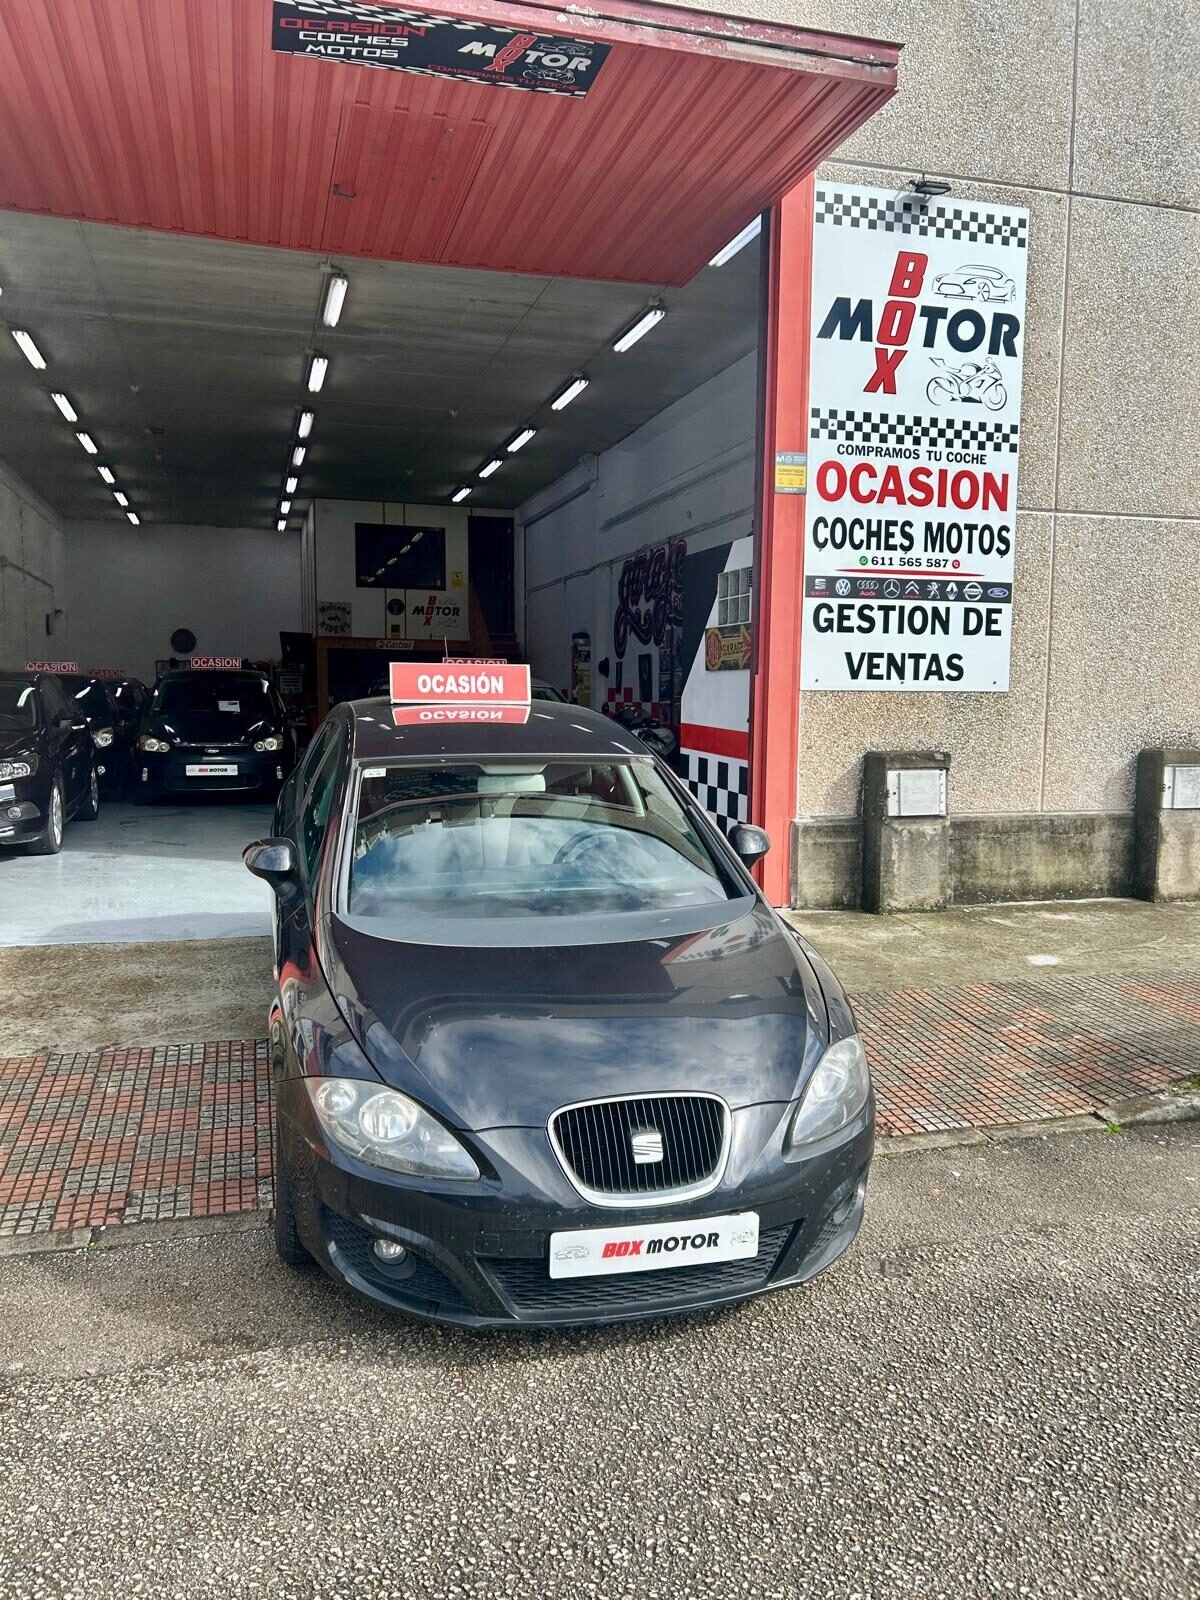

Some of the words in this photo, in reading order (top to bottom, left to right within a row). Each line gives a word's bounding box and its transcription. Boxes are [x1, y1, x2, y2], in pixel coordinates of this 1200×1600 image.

[279, 17, 427, 37] OCASION
[298, 32, 409, 47] COCHES
[305, 44, 399, 58] MOTOS
[458, 41, 593, 71] MOTOR
[484, 33, 538, 73] BOX
[427, 63, 515, 82] COMPRAMOS
[518, 76, 534, 85] TU
[816, 297, 1021, 358] MOTOR
[863, 250, 929, 395] BOX
[837, 443, 920, 459] COMPRAMOS
[926, 450, 942, 462] TU
[946, 452, 987, 465] COCHE
[816, 460, 1009, 511] OCASION
[812, 516, 914, 552] COCHES
[923, 521, 1011, 556] MOTOS
[871, 556, 894, 566] 611
[898, 557, 922, 568] 565
[926, 558, 949, 568] 587
[411, 605, 460, 617] MOTOR
[423, 595, 438, 626] BOX
[812, 602, 951, 636] GESTION
[963, 607, 1003, 637] DE
[385, 640, 412, 650] Castrol
[27, 662, 77, 672] OCASION
[192, 658, 241, 668] OCASION
[845, 652, 965, 681] VENTAS
[417, 672, 504, 694] OCASIÓN
[601, 1239, 645, 1259] BOX
[646, 1232, 720, 1255] MOTOR
